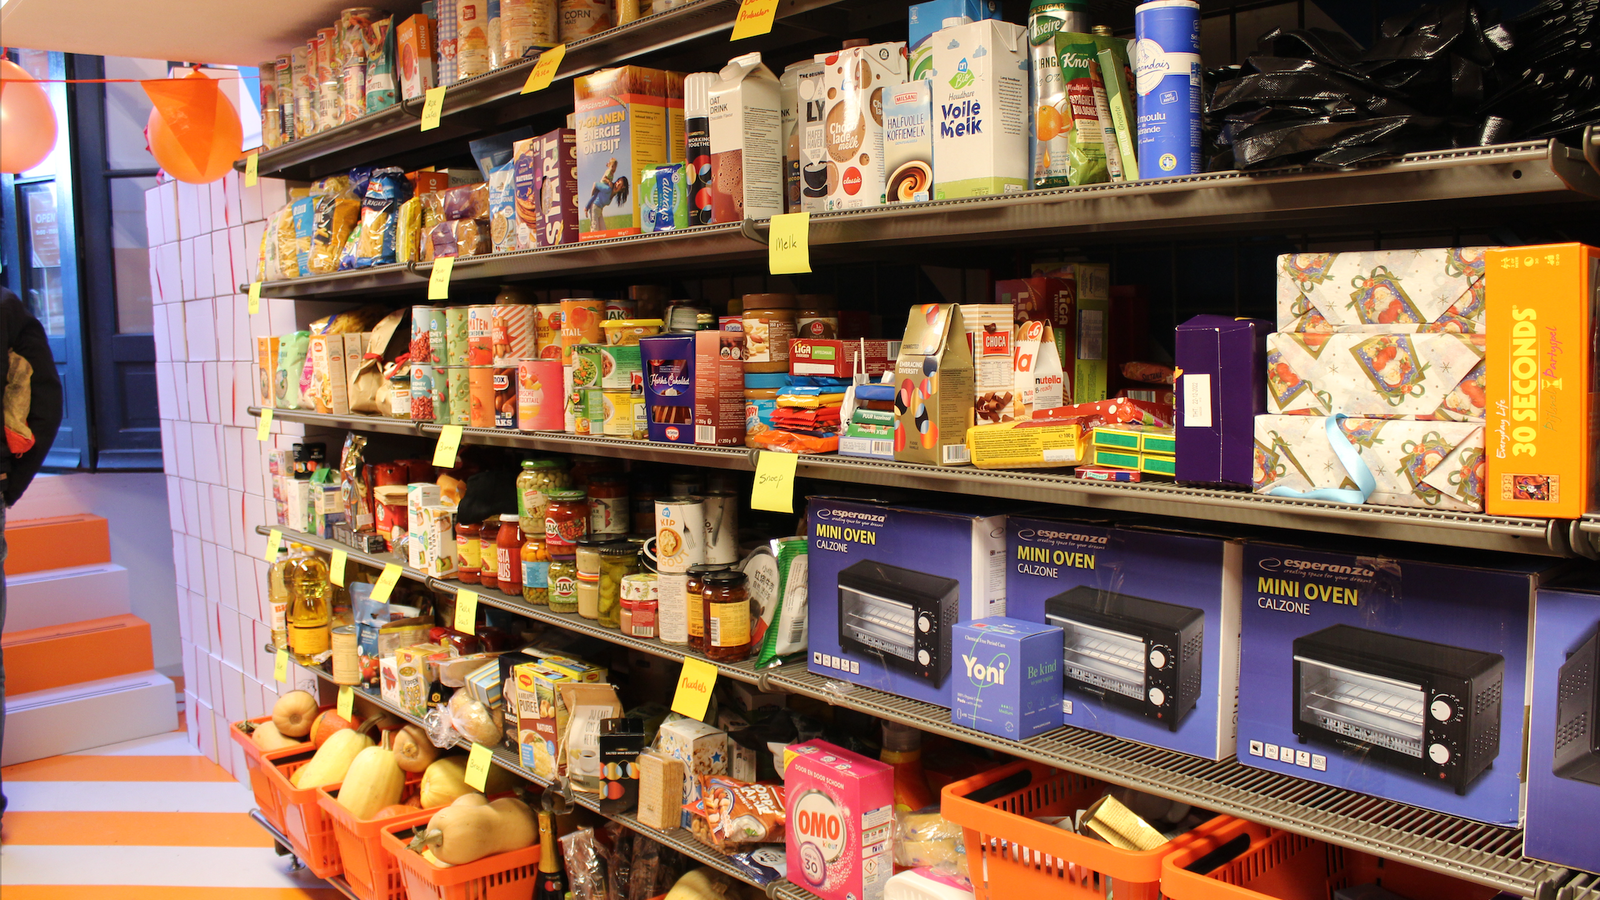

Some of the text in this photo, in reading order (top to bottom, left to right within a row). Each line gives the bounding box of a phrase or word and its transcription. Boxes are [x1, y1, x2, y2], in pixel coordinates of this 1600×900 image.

[564, 9, 591, 20] CORN
[1037, 2, 1065, 13] SUGAR
[1061, 52, 1092, 69] Kno
[710, 96, 720, 105] OAT
[948, 91, 975, 101] Houdbare
[710, 103, 728, 114] DRINK
[578, 110, 626, 130] 7-GRANEN
[887, 113, 924, 129] HALFVOLLE
[1114, 105, 1125, 130] Groente
[583, 125, 621, 143] ENERGIE
[807, 128, 823, 139] HAFER
[887, 125, 926, 141] KOFFIEMELK
[583, 138, 621, 155] ONTBIJT
[838, 135, 859, 151] melk
[843, 177, 861, 185] classic
[544, 138, 561, 245] START
[662, 178, 673, 222] always
[36, 213, 56, 224] OPEN
[776, 233, 797, 251] Melk
[899, 361, 923, 369] EMBRACING
[1035, 375, 1062, 384] nutella
[1512, 308, 1537, 457] 30 SECONDS
[1494, 399, 1511, 459] Everyday Life
[759, 473, 784, 488] Snoep
[660, 519, 676, 527] KIP
[831, 509, 886, 523] esperanza
[816, 523, 876, 545] MINI OVEN
[1037, 529, 1108, 544] esperanza
[816, 539, 848, 553] CALZONE
[1017, 545, 1095, 570] MINI OVEN
[1017, 563, 1058, 578] CALZONE
[1283, 558, 1375, 577] esperanza
[555, 582, 575, 592] HAK
[1257, 576, 1358, 606] MINI OVEN
[1257, 597, 1311, 615] CALZONE
[962, 654, 1005, 685] Yoni
[1027, 659, 1057, 679] Be kind
[519, 699, 538, 713] PUREE
[536, 722, 554, 734] NATUREL
[794, 764, 845, 790] DOOR EN DOOR SCHOON
[798, 809, 840, 841] OMO
[822, 841, 838, 850] kleur
[805, 857, 818, 874] 30
